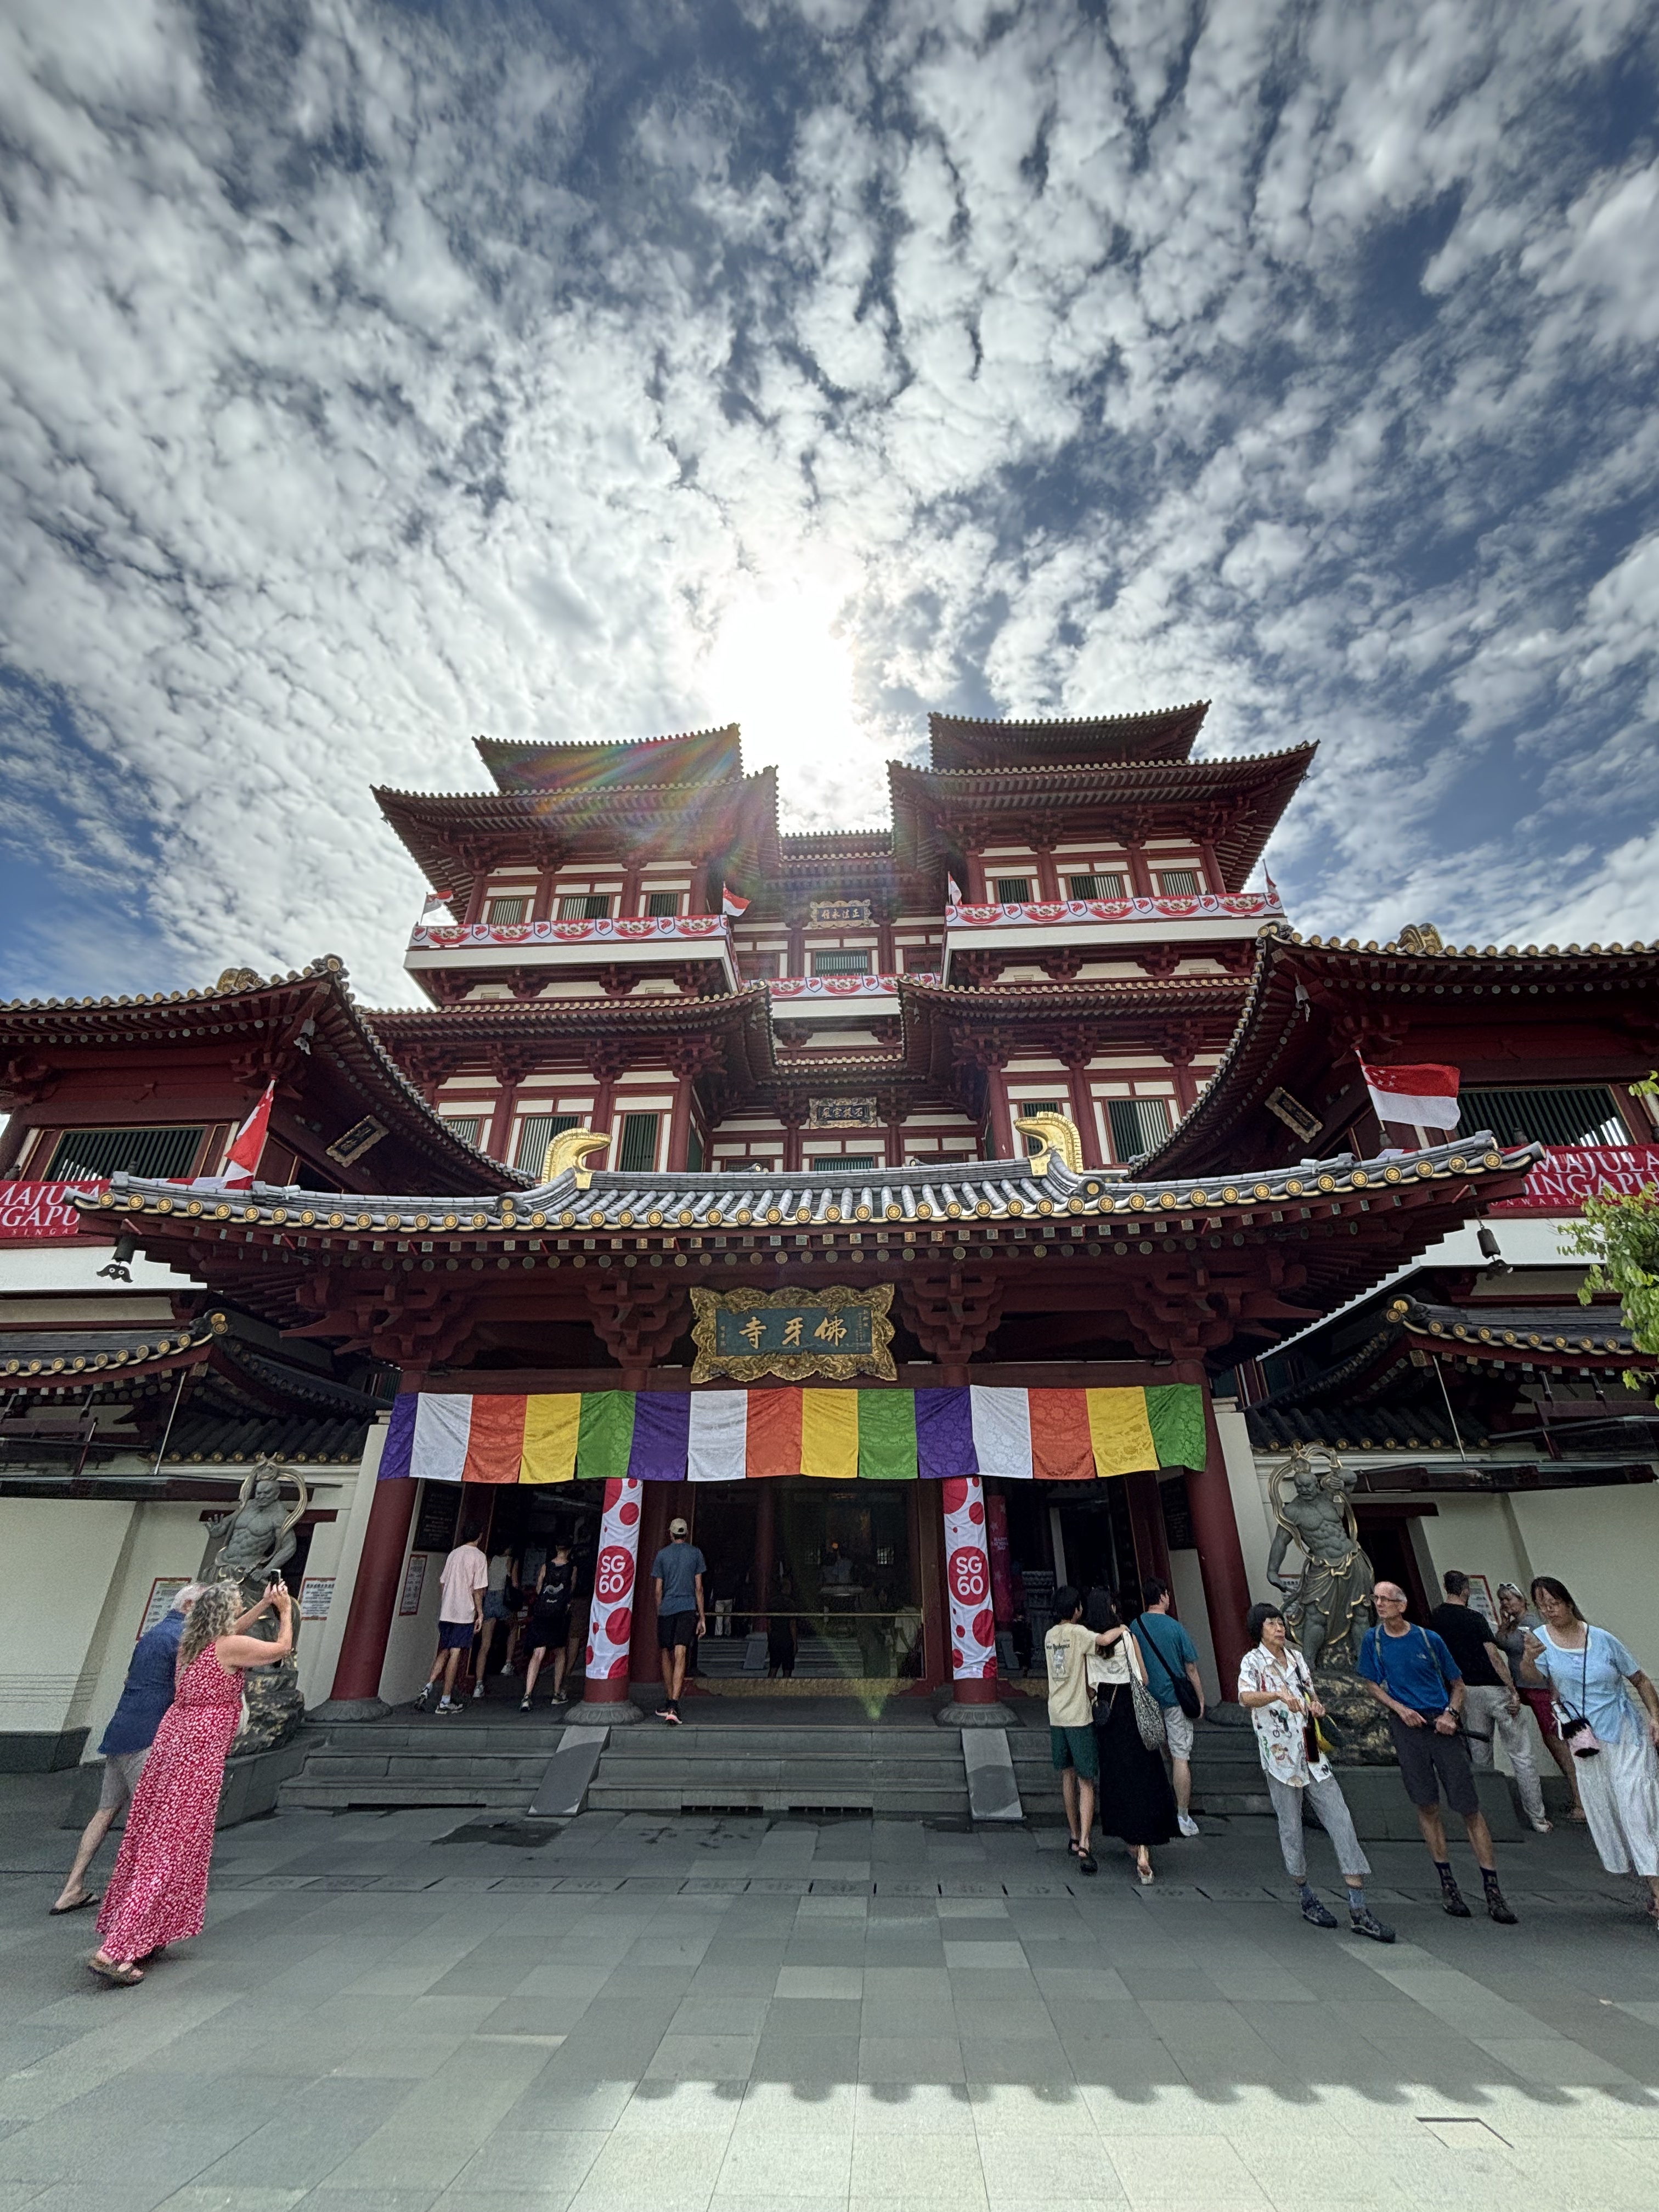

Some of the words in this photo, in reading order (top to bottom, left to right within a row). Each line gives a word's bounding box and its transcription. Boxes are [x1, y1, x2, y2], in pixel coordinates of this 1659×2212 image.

[739, 1316, 847, 1349] 佛牙寺
[600, 1555, 625, 1573] SG
[956, 1556, 982, 1575] SG
[599, 1573, 624, 1594] 60
[957, 1575, 983, 1595] 60
